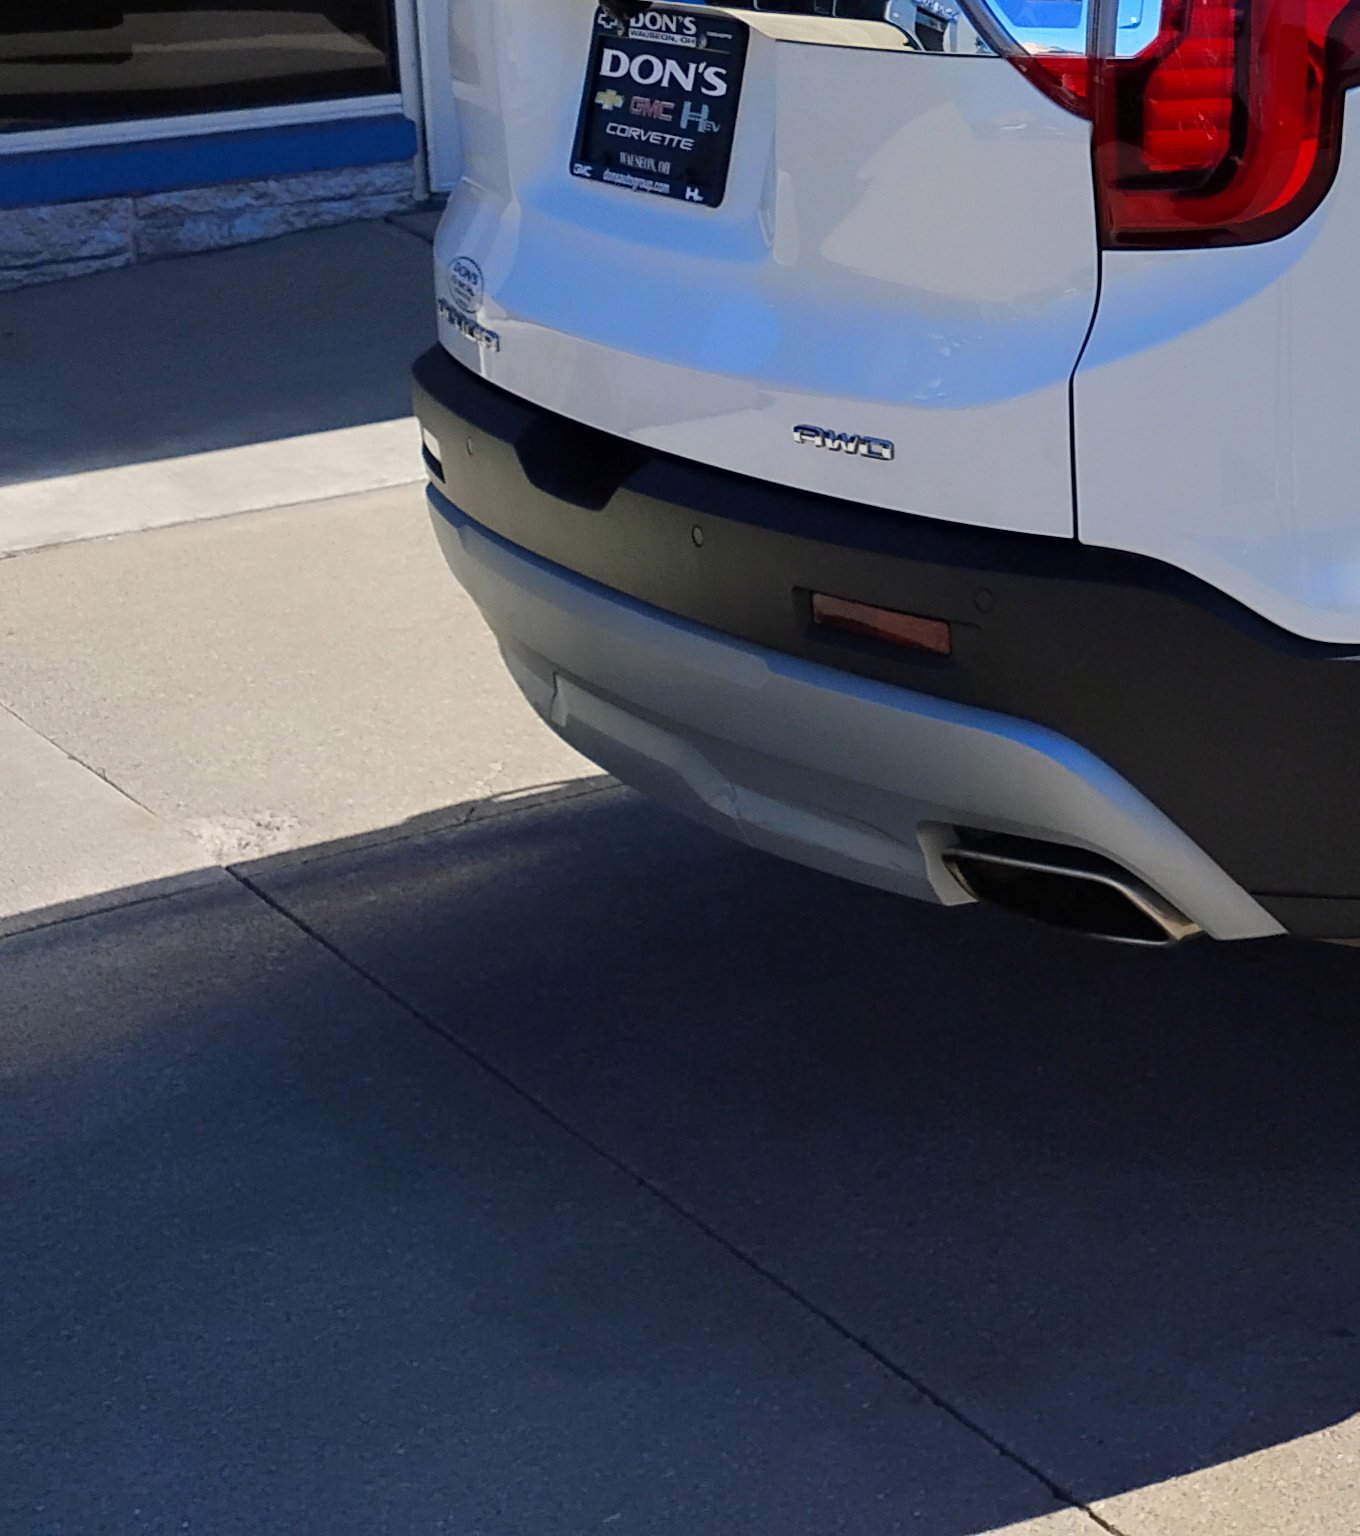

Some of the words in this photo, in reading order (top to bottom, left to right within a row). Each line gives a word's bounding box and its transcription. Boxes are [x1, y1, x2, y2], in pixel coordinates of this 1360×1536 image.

[629, 12, 697, 35] DON'S
[680, 36, 696, 45] OH
[600, 48, 728, 97] DON'S
[630, 96, 676, 122] GMC
[606, 122, 695, 150] CORVETTE
[793, 424, 894, 461] AWD
